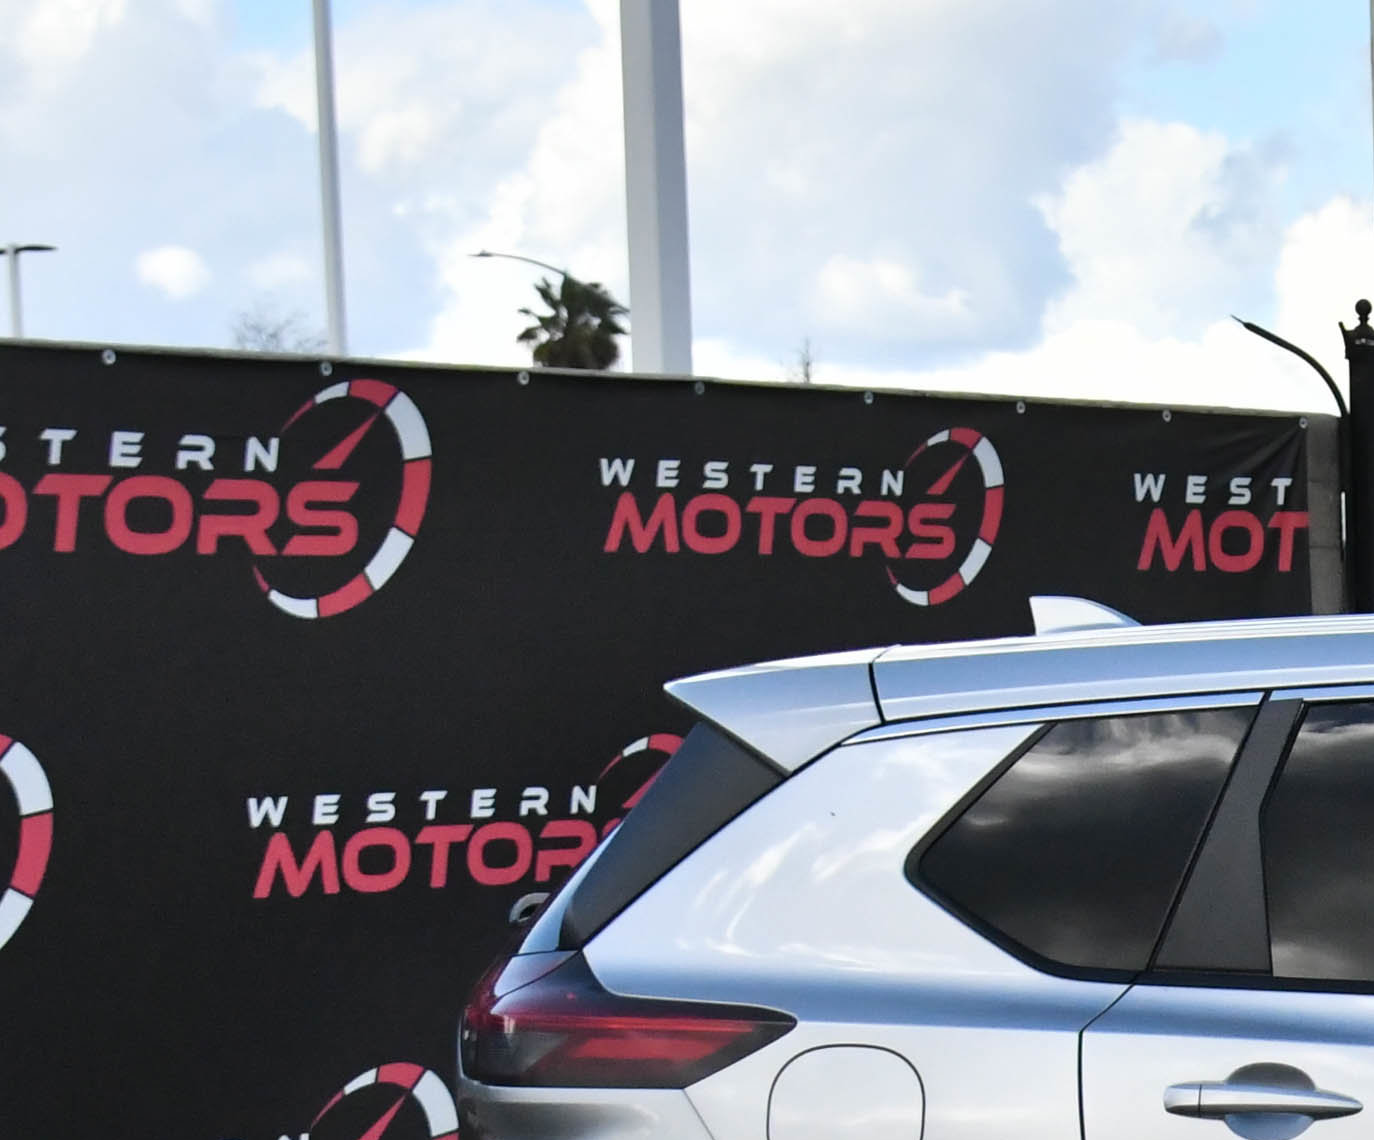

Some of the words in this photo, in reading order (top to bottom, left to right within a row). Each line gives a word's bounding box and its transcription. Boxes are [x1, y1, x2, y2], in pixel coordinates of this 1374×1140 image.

[0, 427, 280, 472] TERN
[600, 458, 904, 497] WESTERN
[1134, 473, 1293, 505] WEST
[604, 492, 956, 559] MOTORS
[1137, 509, 1310, 572] MOT
[247, 785, 597, 828] WESTERN
[252, 818, 624, 899] MOTOR
